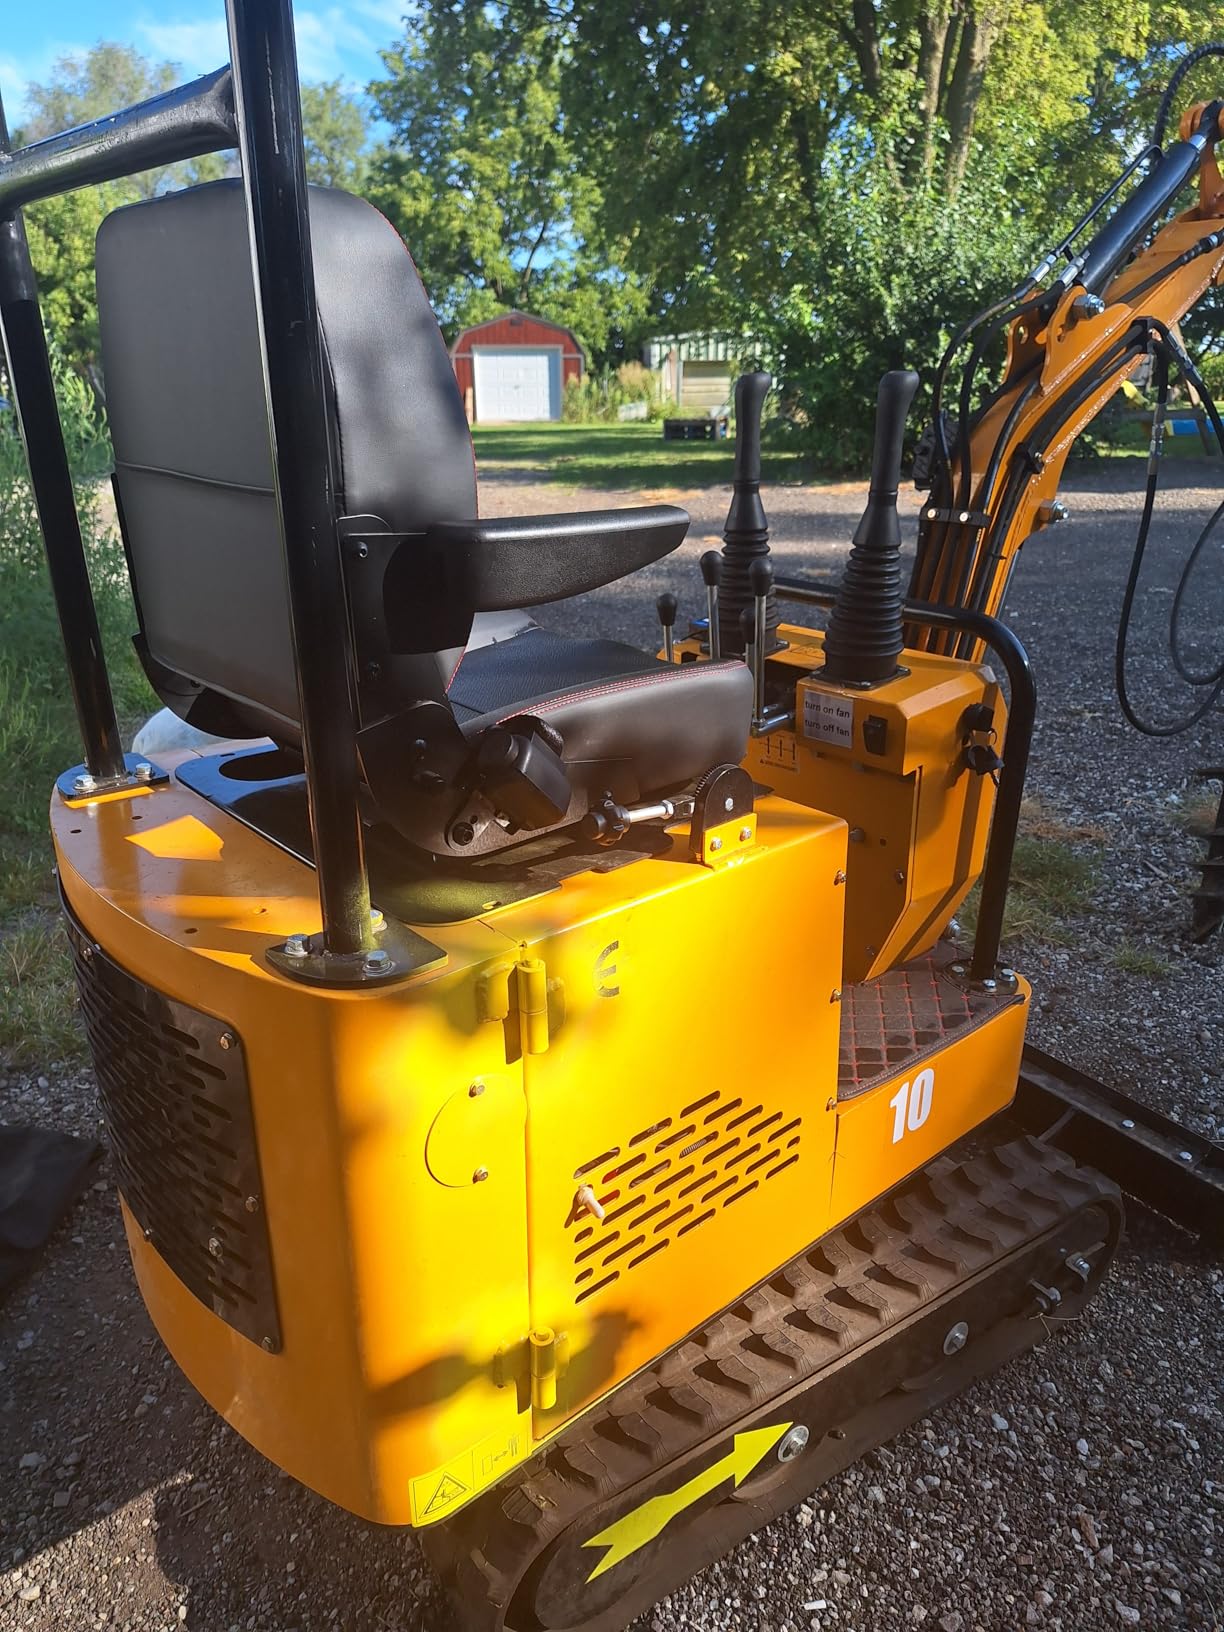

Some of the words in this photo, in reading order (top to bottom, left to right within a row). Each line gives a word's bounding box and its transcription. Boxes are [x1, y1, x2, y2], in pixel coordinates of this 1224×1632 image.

[805, 701, 821, 711] turn
[836, 708, 850, 718] fan
[805, 719, 821, 729] turn
[823, 724, 834, 732] off
[836, 726, 850, 737] fan
[889, 1068, 935, 1144] 10
